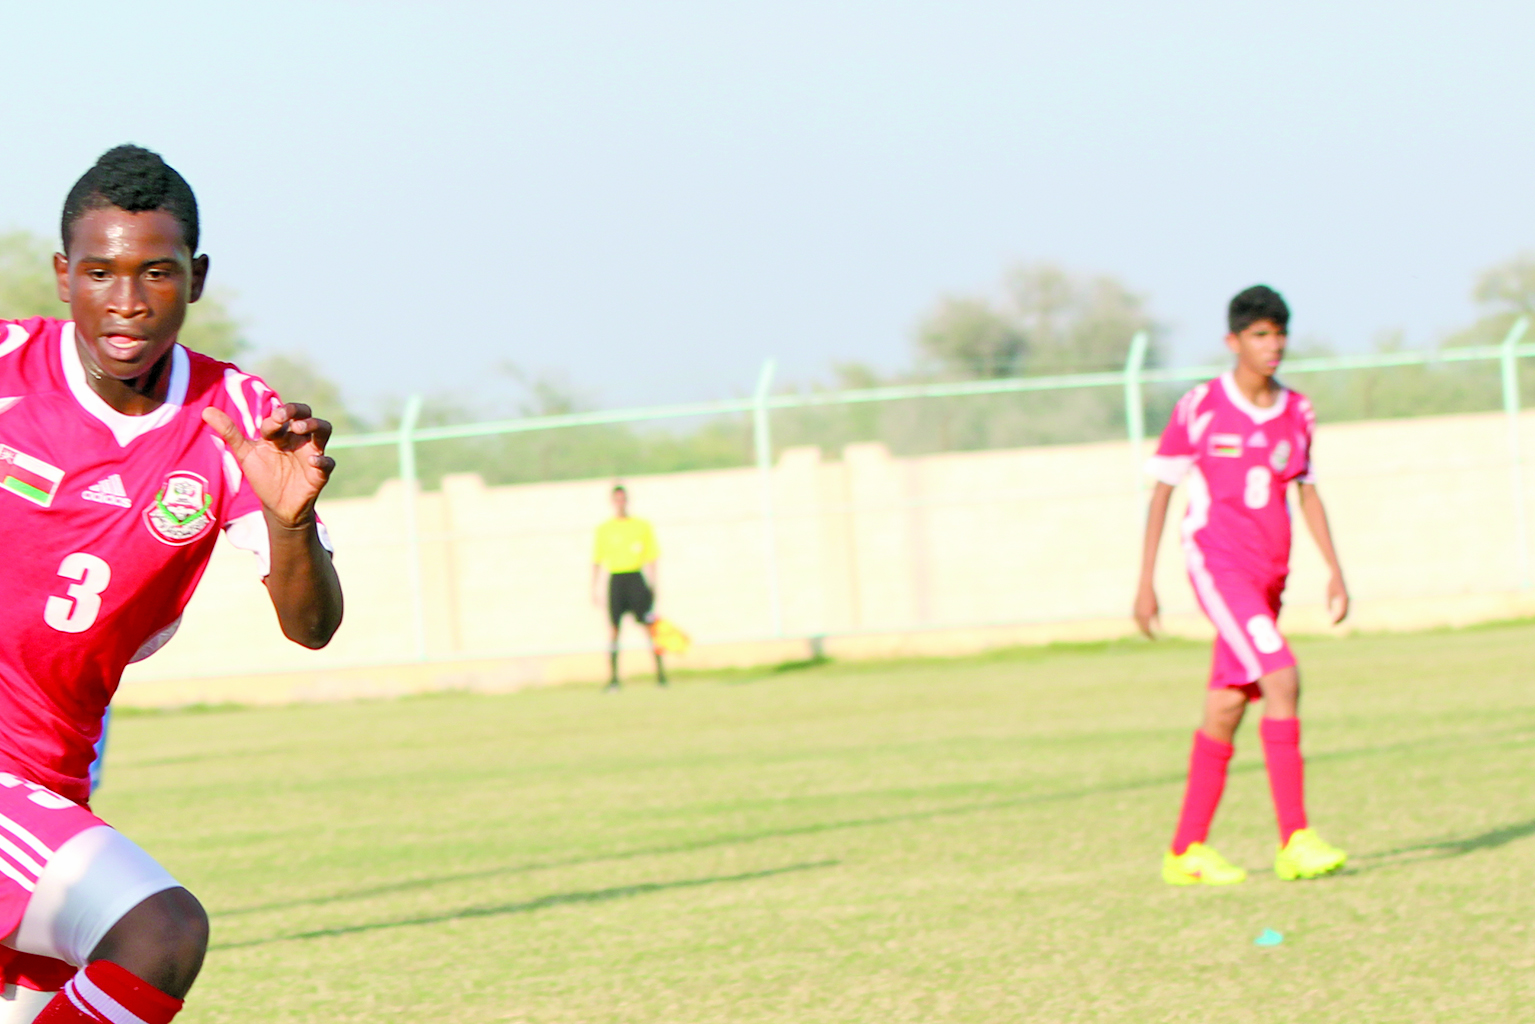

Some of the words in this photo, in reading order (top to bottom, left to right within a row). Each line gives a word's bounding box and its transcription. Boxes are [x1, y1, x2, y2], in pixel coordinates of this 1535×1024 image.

[81, 490, 132, 509] adidas
[1244, 465, 1271, 509] 8
[43, 552, 112, 634] 3
